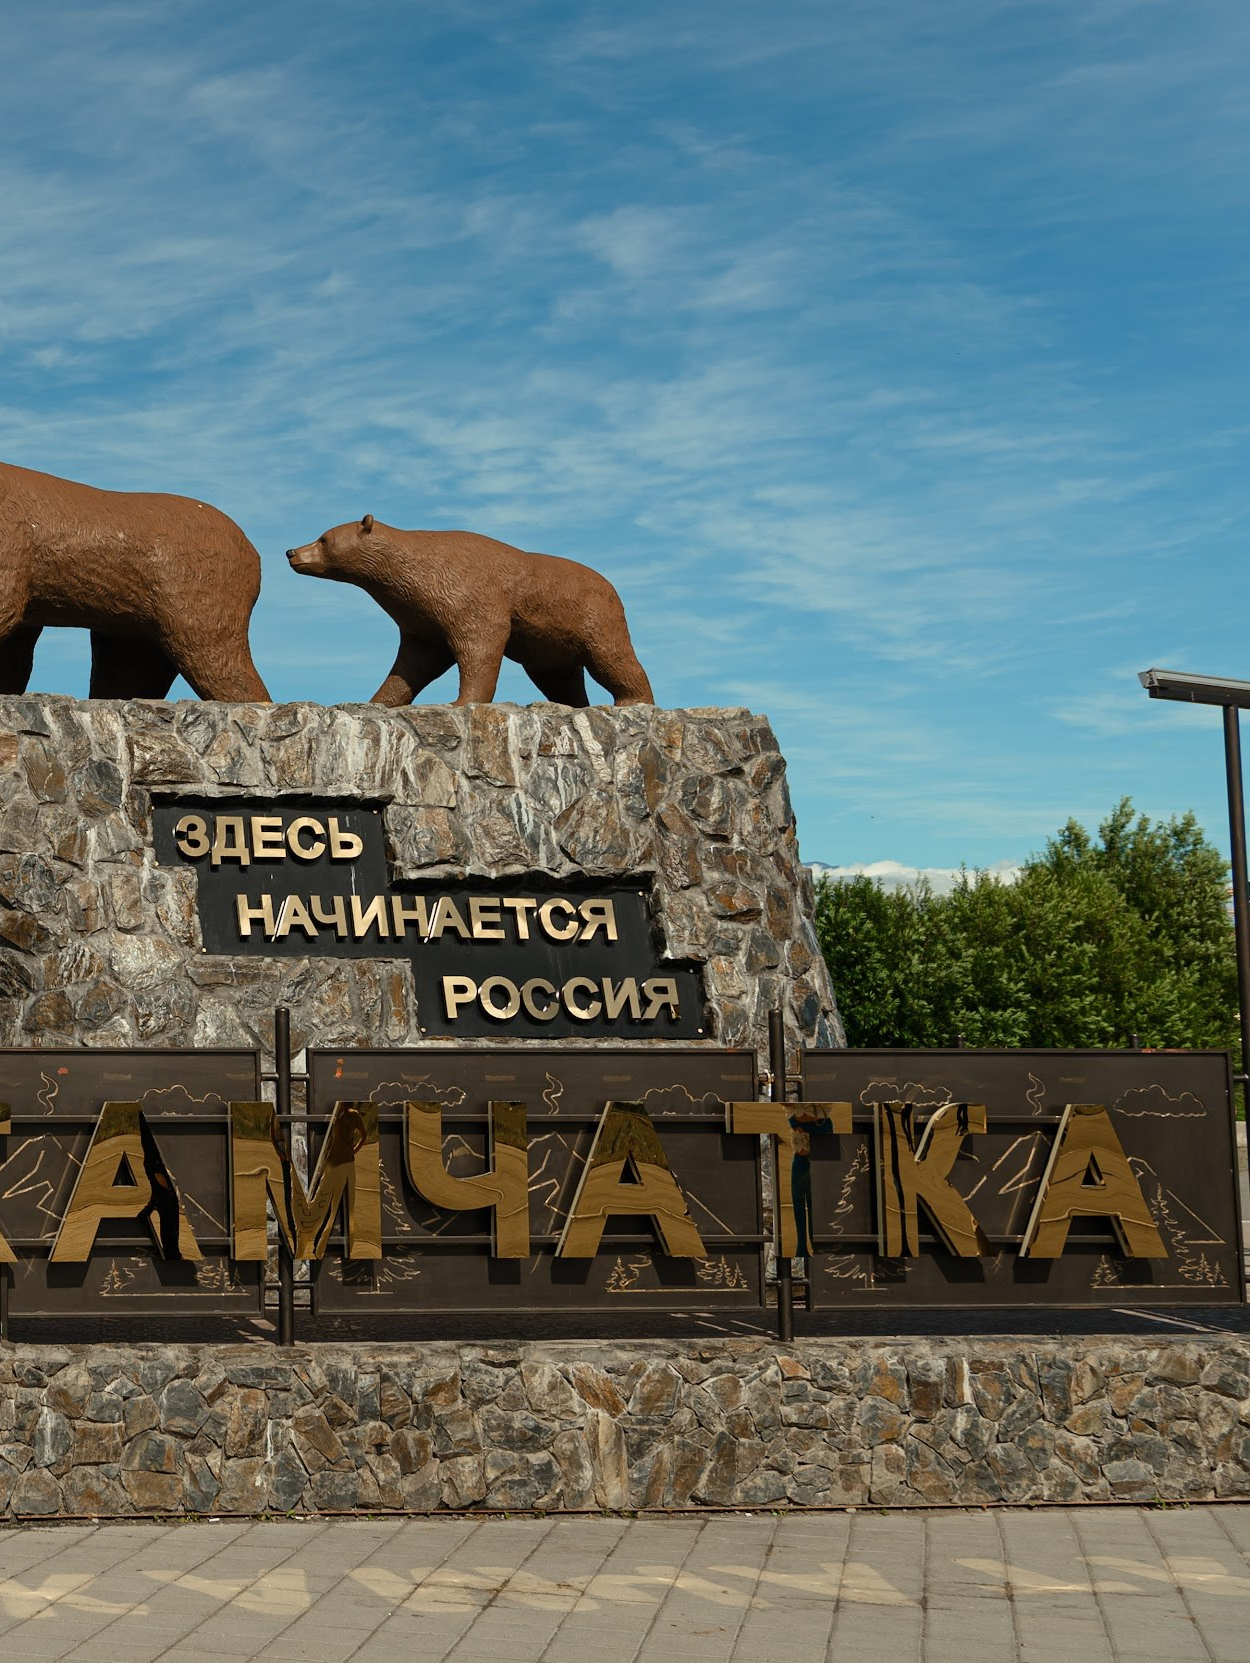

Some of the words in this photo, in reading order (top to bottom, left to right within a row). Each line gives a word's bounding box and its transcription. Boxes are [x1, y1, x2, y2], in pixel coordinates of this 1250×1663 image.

[174, 814, 364, 866] ЗДЕСЬ
[236, 893, 618, 942] НАЧИНАЕТСЯ
[442, 975, 680, 1020] РОССИЯ
